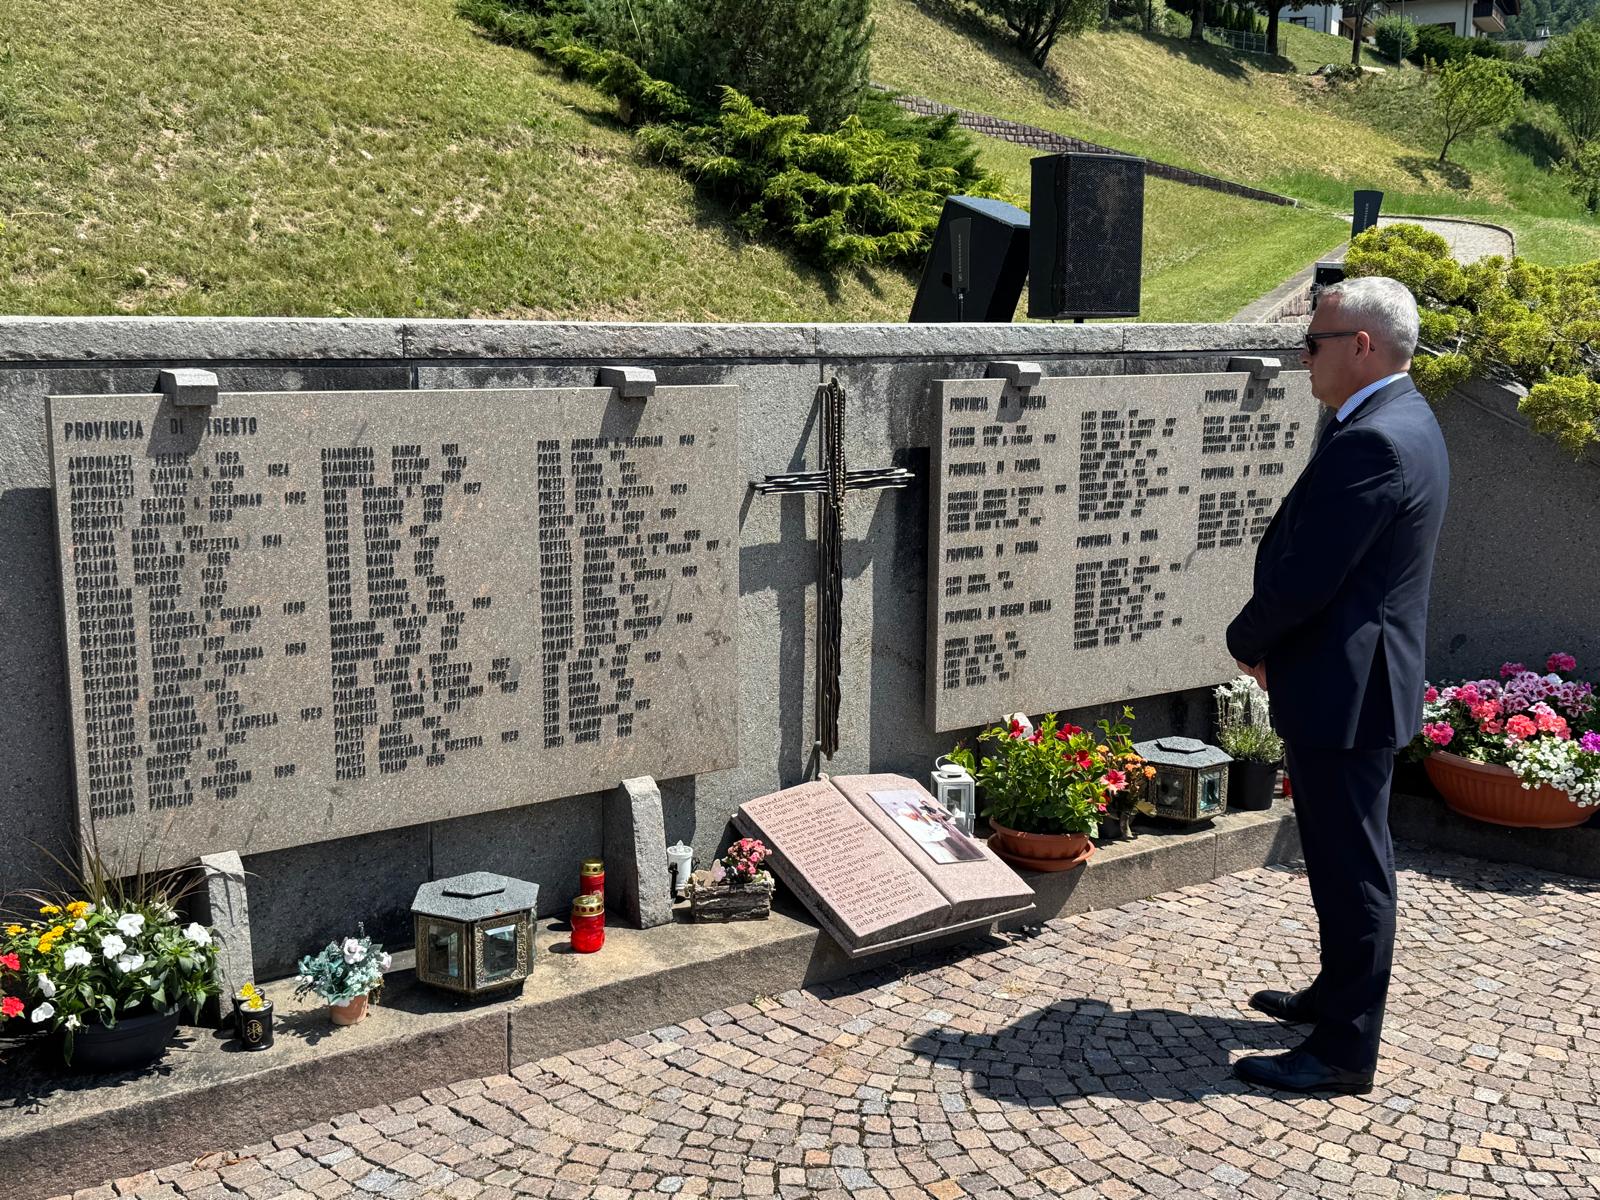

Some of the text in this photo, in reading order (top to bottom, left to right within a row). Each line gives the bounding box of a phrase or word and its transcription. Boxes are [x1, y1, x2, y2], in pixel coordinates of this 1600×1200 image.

[65, 417, 258, 442] PROVINCIA DI TRENTO
[68, 452, 192, 470] ANTONIAZZI FELICE
[392, 458, 429, 470] STEFANO
[69, 469, 133, 485] ANTONIAZZI
[150, 467, 193, 482] SALVINA
[219, 465, 243, 478] MICH
[71, 482, 187, 500] ANTONIAZZI VITALE
[324, 489, 346, 501] MICH
[141, 497, 184, 512] FELICITA
[324, 502, 347, 515] MICH
[325, 516, 348, 528] MICH
[72, 530, 114, 545] COLLINA
[325, 529, 348, 542] MICH
[73, 545, 115, 560] COLLINA
[132, 542, 165, 555] MARIA
[74, 560, 117, 574] COLLINA
[76, 575, 118, 590] COLLINA
[327, 570, 349, 583] MICH
[149, 584, 181, 598] ALCIDE
[149, 599, 175, 612] ANNA
[150, 624, 206, 642] ELISABETTA
[151, 641, 179, 656] LUCIO
[148, 696, 193, 712] GIOVANNI
[149, 709, 196, 727] GIULIANA
[146, 752, 191, 769] GIUSEPPE
[148, 782, 173, 797] LIVIA
